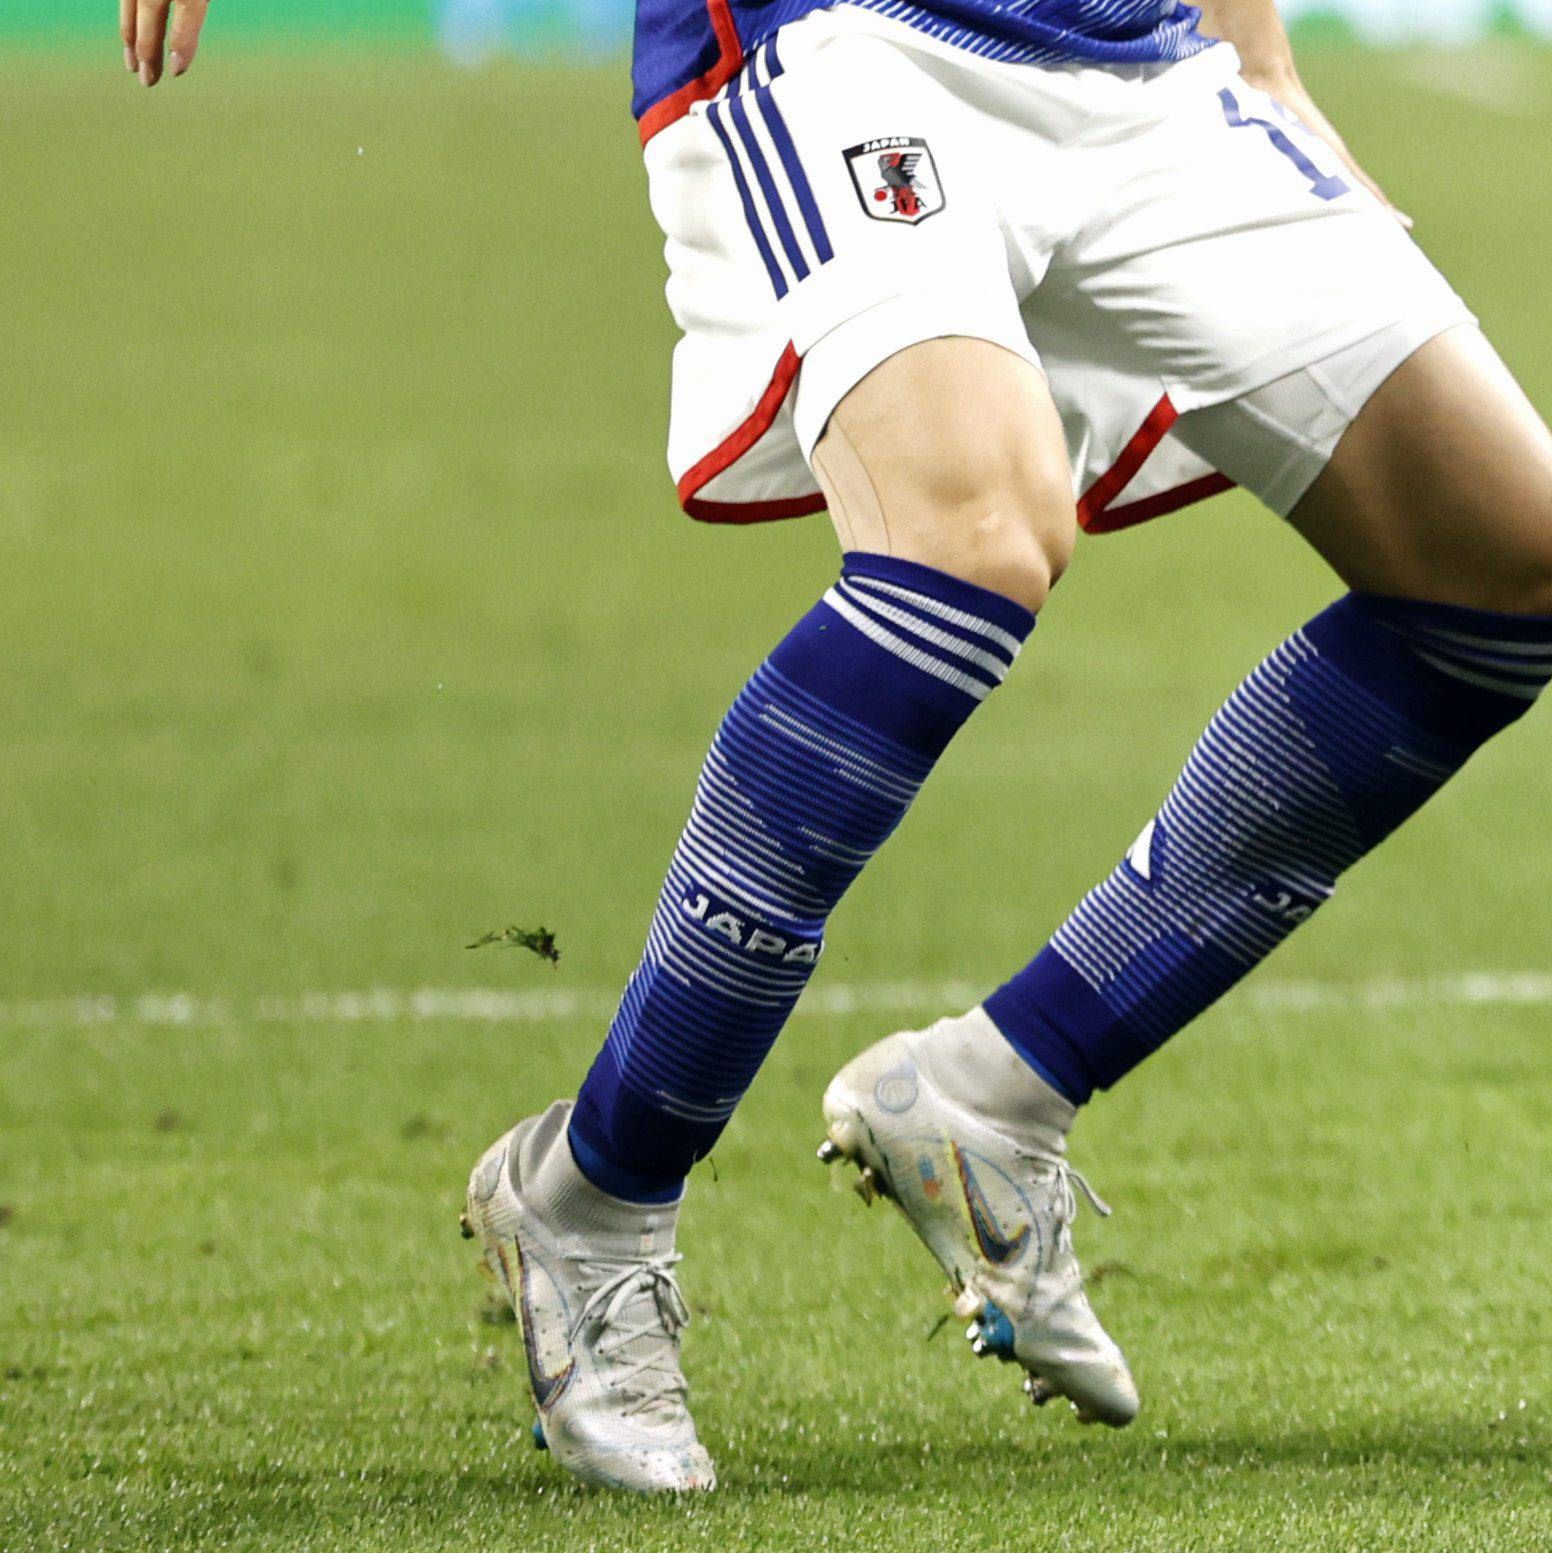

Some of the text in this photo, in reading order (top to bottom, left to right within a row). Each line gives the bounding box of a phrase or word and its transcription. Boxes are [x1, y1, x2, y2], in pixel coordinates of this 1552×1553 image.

[862, 136, 911, 153] JAPAN
[1216, 86, 1352, 202] 1
[682, 894, 826, 965] JAPA
